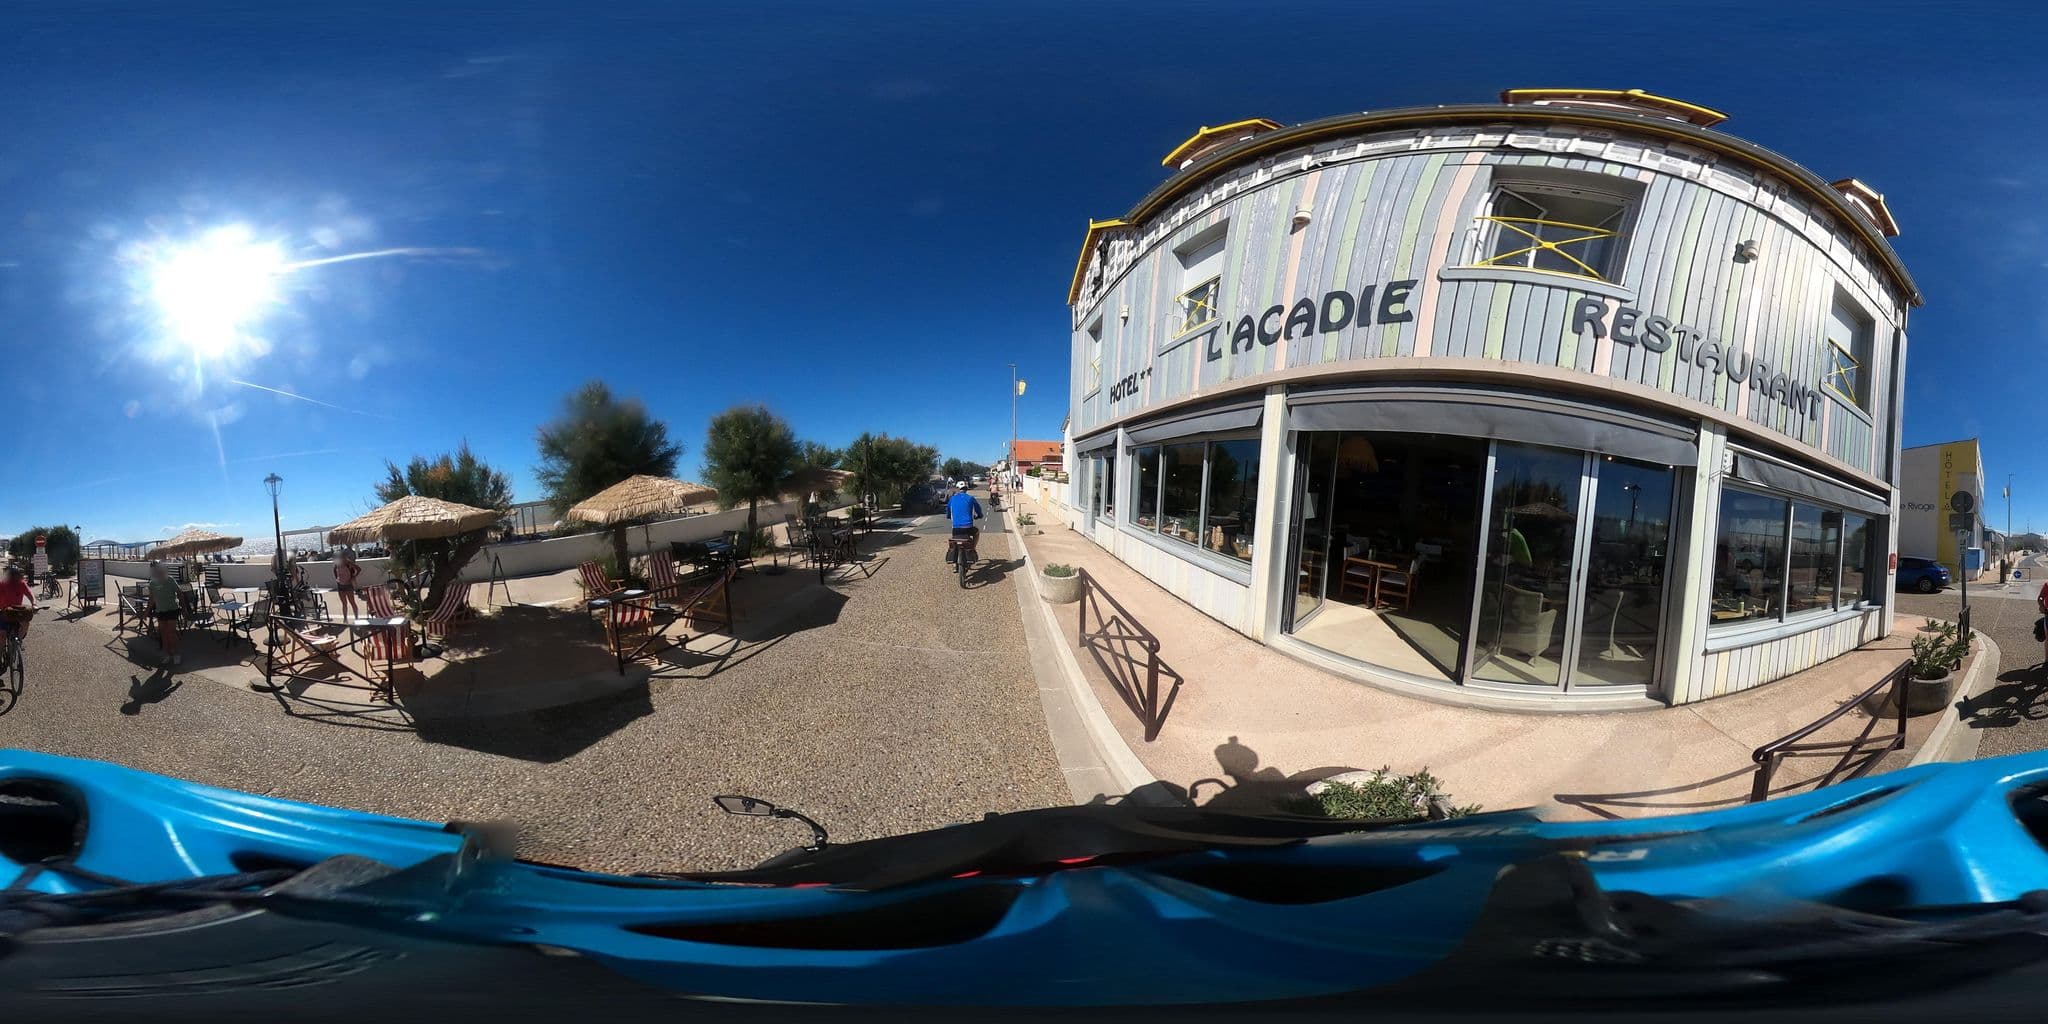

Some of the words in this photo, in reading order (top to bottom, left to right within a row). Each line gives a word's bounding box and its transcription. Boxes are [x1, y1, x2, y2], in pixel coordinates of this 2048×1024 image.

[1207, 280, 1418, 362] L'ACADIE
[1571, 297, 1822, 421] RESTAURANT
[1907, 502, 1936, 512] Rivage
[1945, 451, 1953, 500] HOTEL
